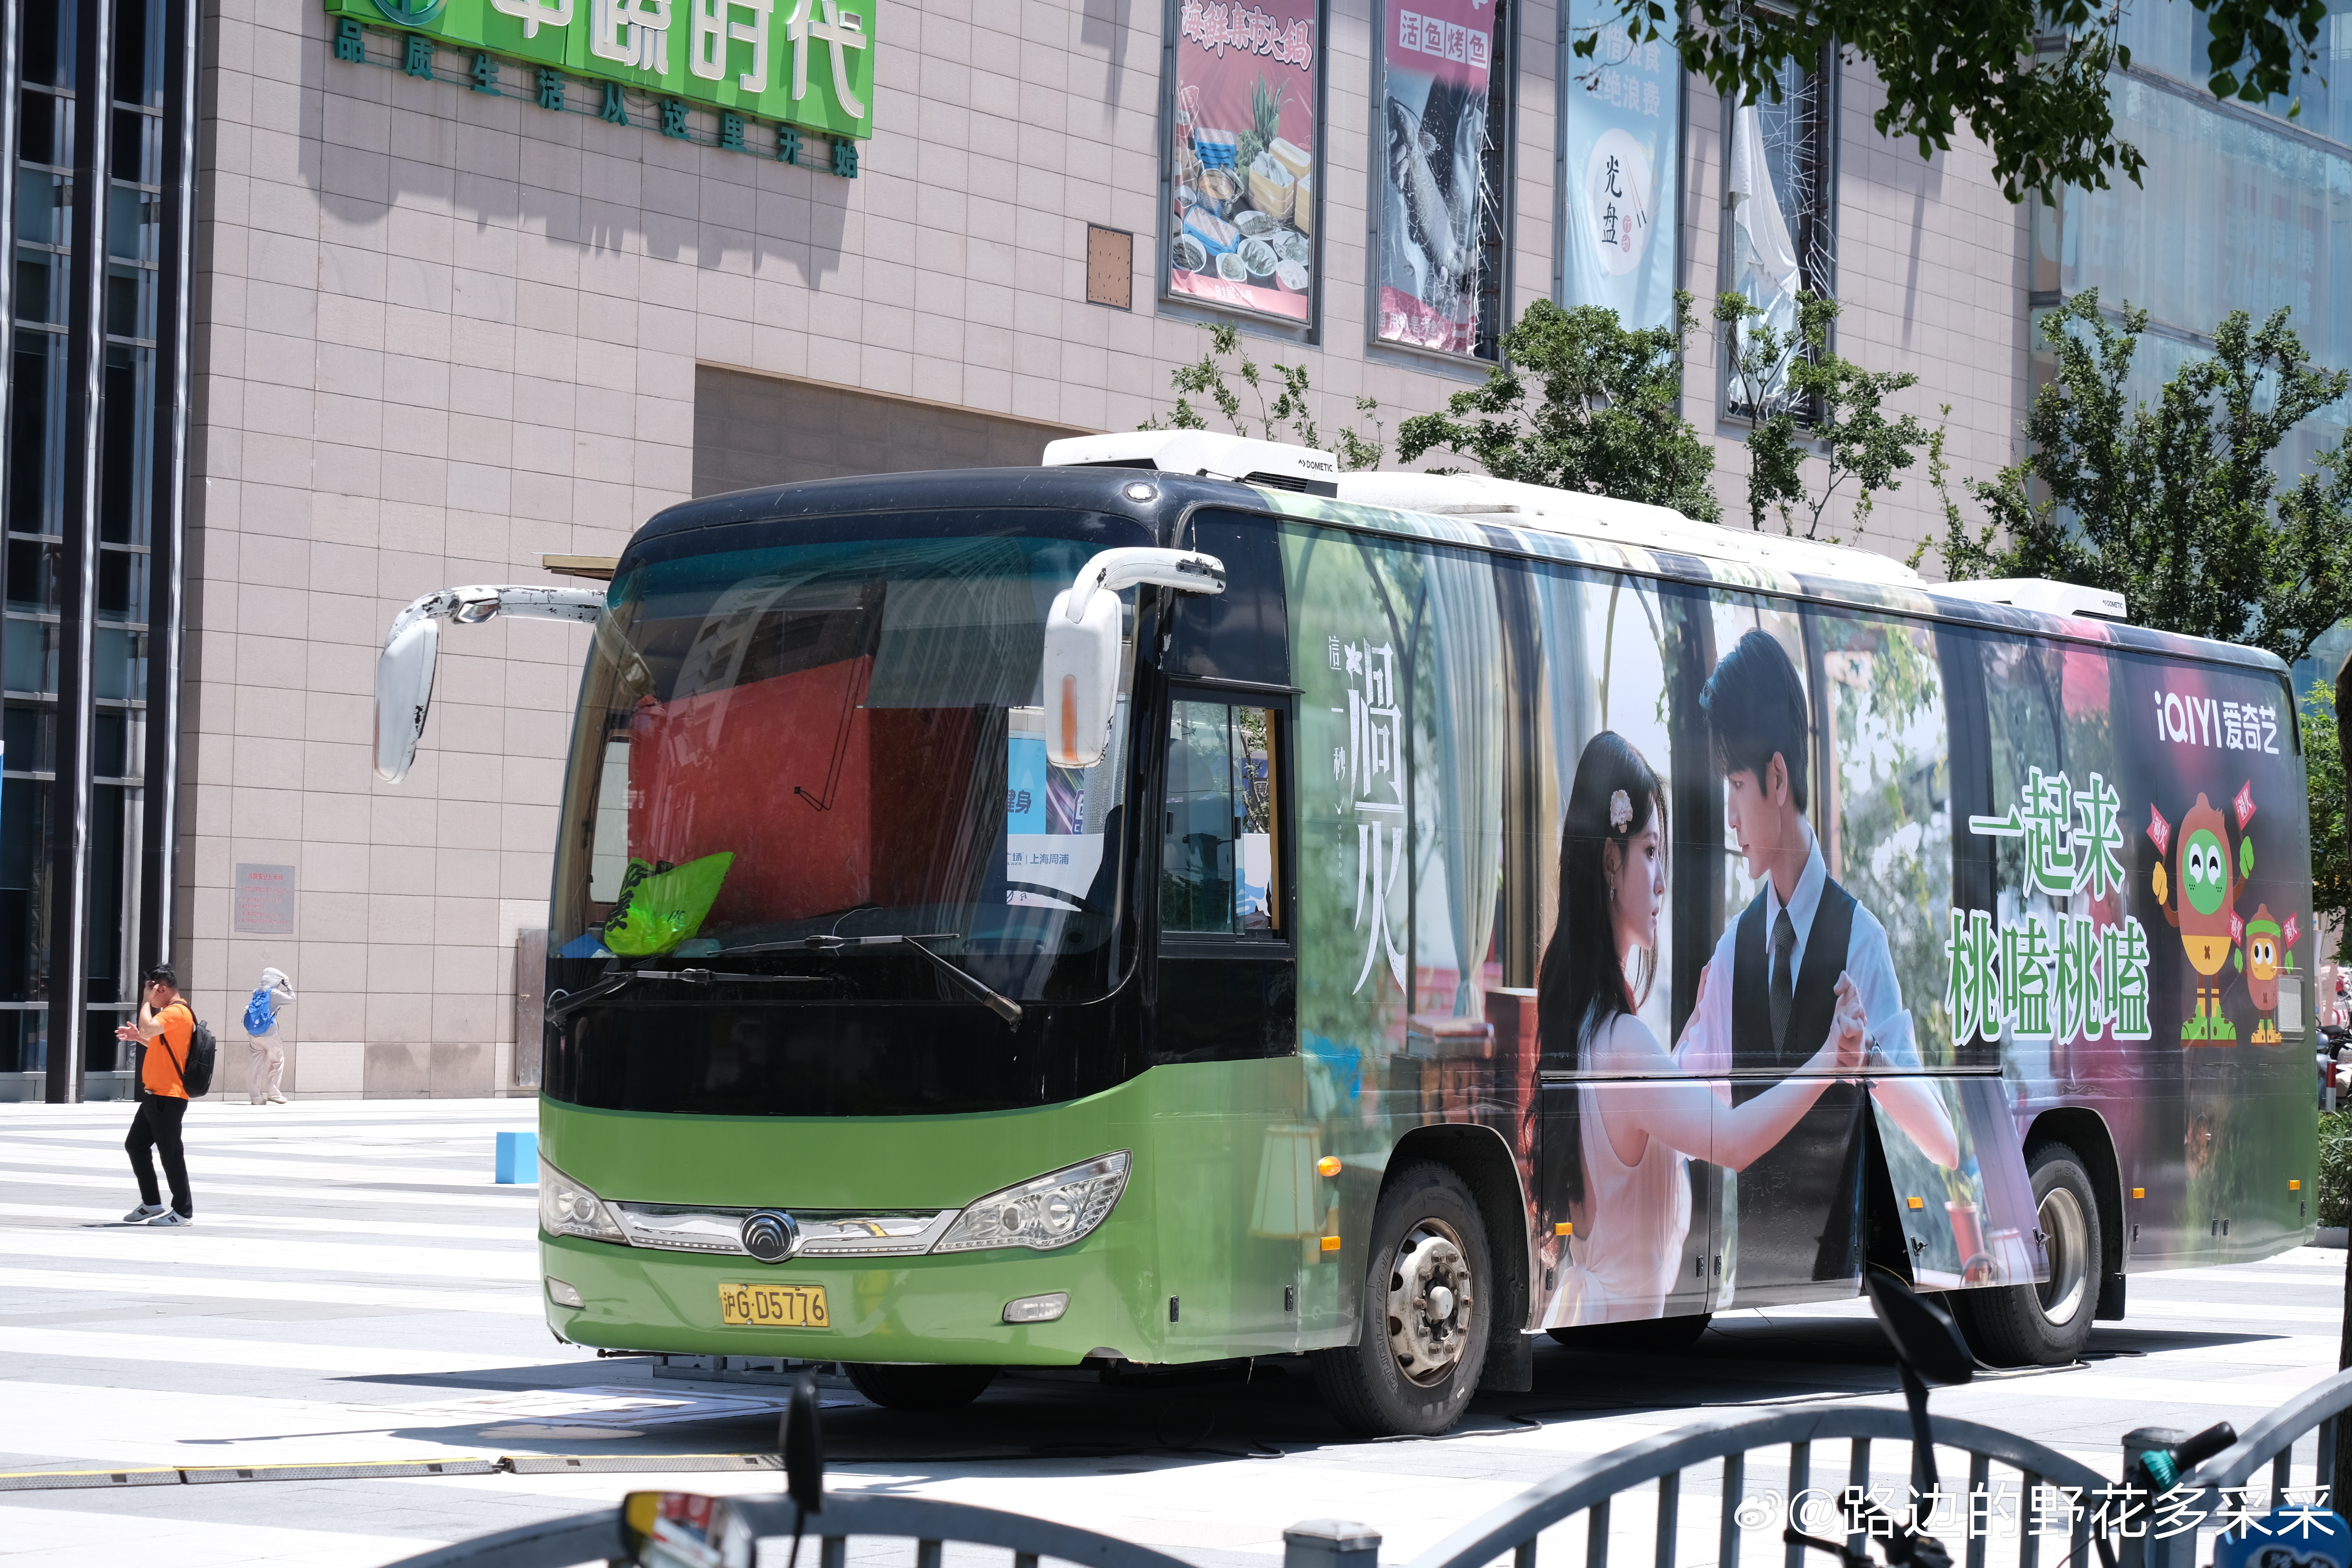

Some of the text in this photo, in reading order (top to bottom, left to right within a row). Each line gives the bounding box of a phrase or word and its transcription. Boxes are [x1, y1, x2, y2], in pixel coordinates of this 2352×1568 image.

[1181, 0, 1312, 70] 海鮮集市火鍋
[1401, 14, 1486, 64] 活鱼烤鱼
[334, 18, 859, 179] 品质生活从这里开始
[1602, 155, 1622, 245] 光盘
[1622, 215, 1632, 253] 行动
[1306, 460, 1333, 472] DOMETIC
[2107, 600, 2123, 609] DOMETIC
[2154, 690, 2279, 755] iQIYI 爱奇艺
[1030, 853, 1069, 865] 上海周浦
[1969, 765, 2126, 902] 一起来
[1944, 907, 2152, 1046] 桃嗑桃嗑
[1376, 1234, 1404, 1403] DOUBLE COIN
